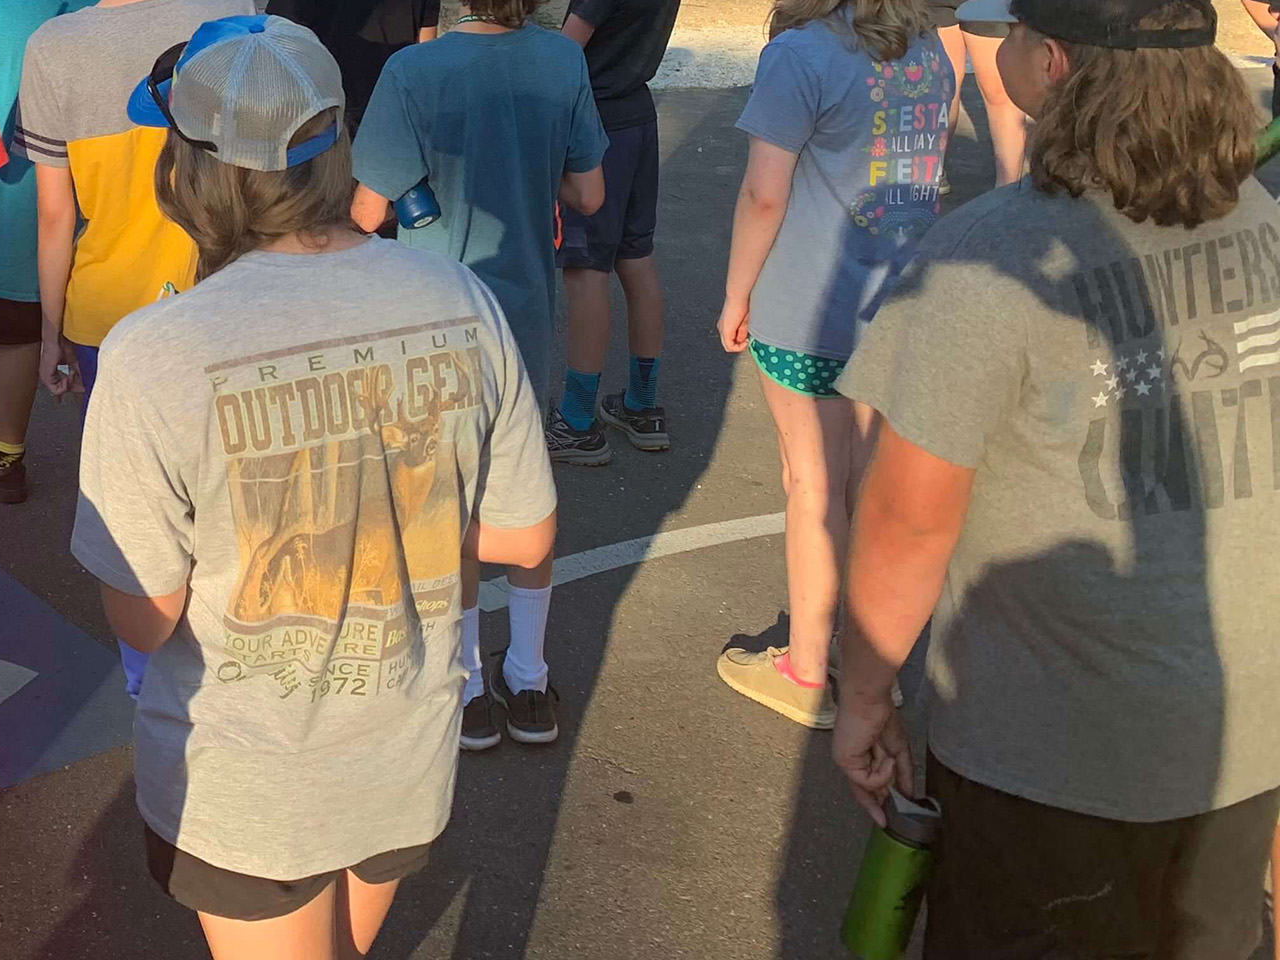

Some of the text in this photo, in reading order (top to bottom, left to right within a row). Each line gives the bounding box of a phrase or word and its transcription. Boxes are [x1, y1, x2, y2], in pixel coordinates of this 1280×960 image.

[913, 133, 936, 151] AY
[885, 184, 939, 205] LL IGHT
[209, 326, 480, 393] PREMIUM
[214, 343, 484, 457] OUTDOOR GE
[225, 622, 378, 656] YOUR ADVEURE
[385, 627, 408, 648] Bas
[224, 647, 312, 665] TARTS
[388, 647, 413, 675] HUN
[308, 662, 371, 688] SNCE
[310, 677, 367, 704] 1972
